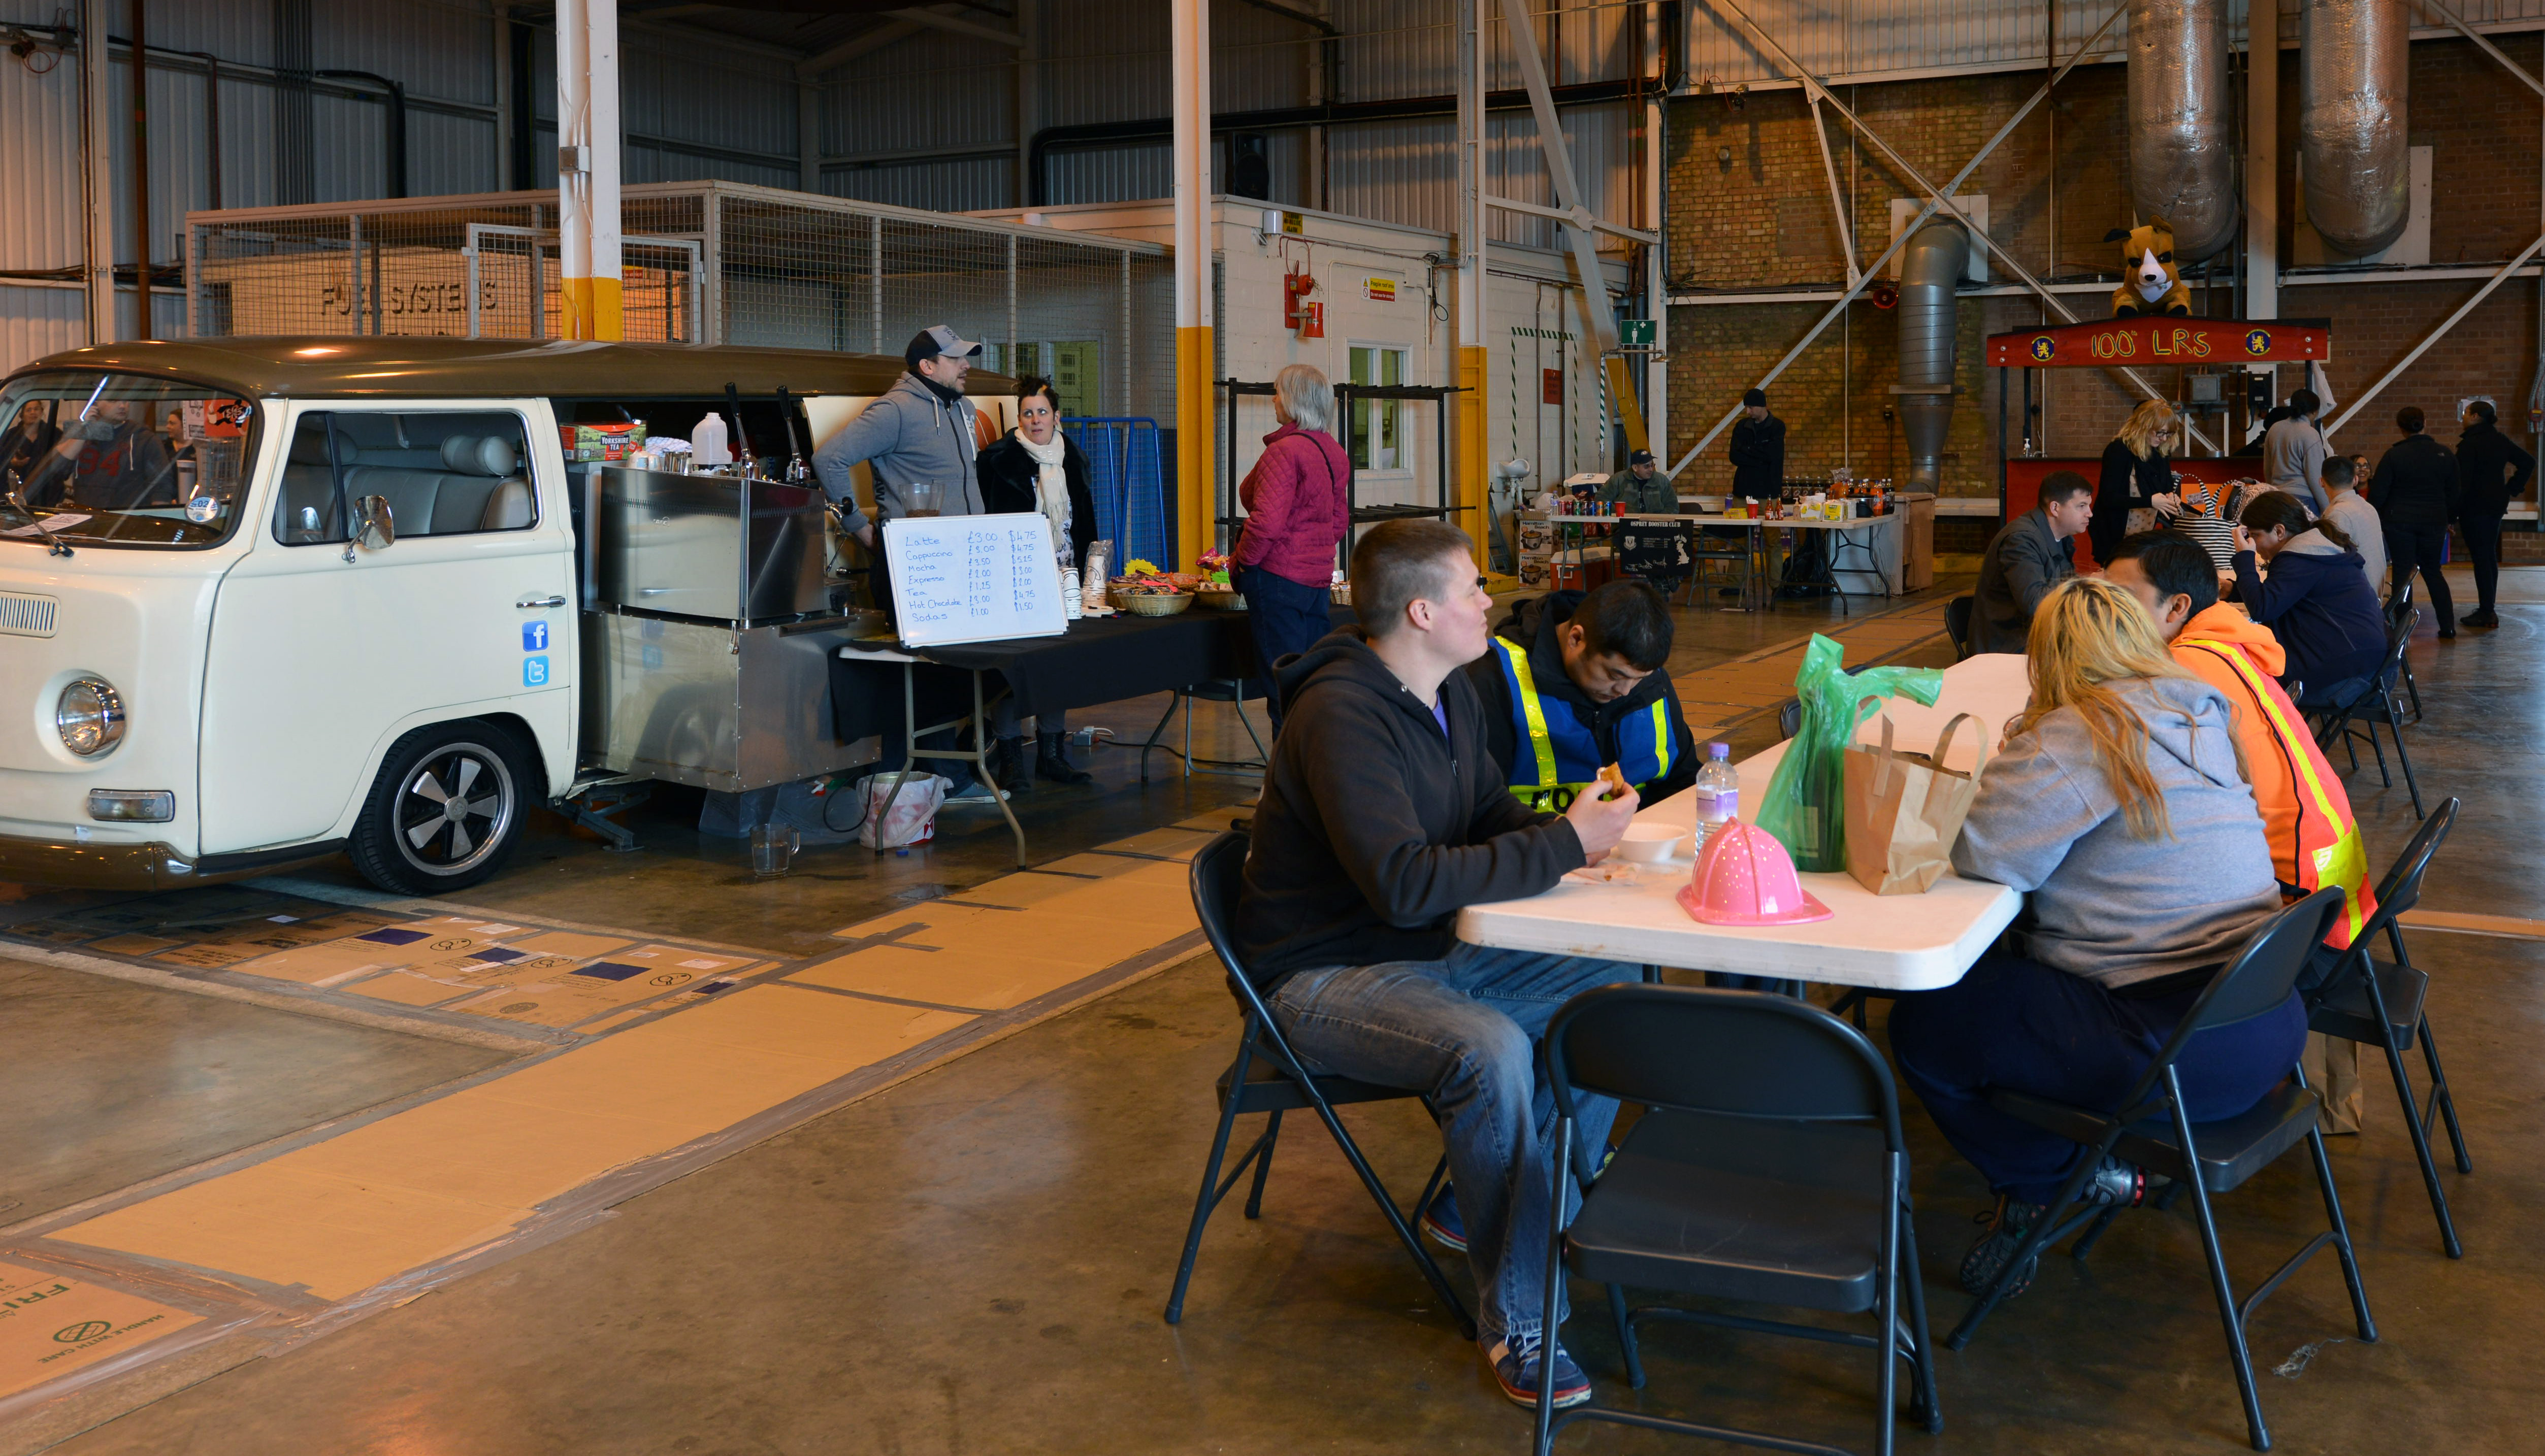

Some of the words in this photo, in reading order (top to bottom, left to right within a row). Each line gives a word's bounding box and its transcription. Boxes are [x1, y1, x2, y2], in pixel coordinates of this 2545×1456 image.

[2152, 328, 2211, 357] LRS
[905, 536, 940, 547] Latte
[905, 550, 953, 562] Cappuccino
[908, 564, 937, 572] Mocha
[908, 575, 945, 586] Expresso
[909, 601, 926, 610] Hot
[928, 598, 962, 609] Chocolate
[912, 613, 948, 622] Sodas
[0, 1283, 71, 1315] FRI
[112, 1314, 165, 1336] HANDLE
[76, 1334, 114, 1350] WITH
[37, 1348, 76, 1364] CARE
